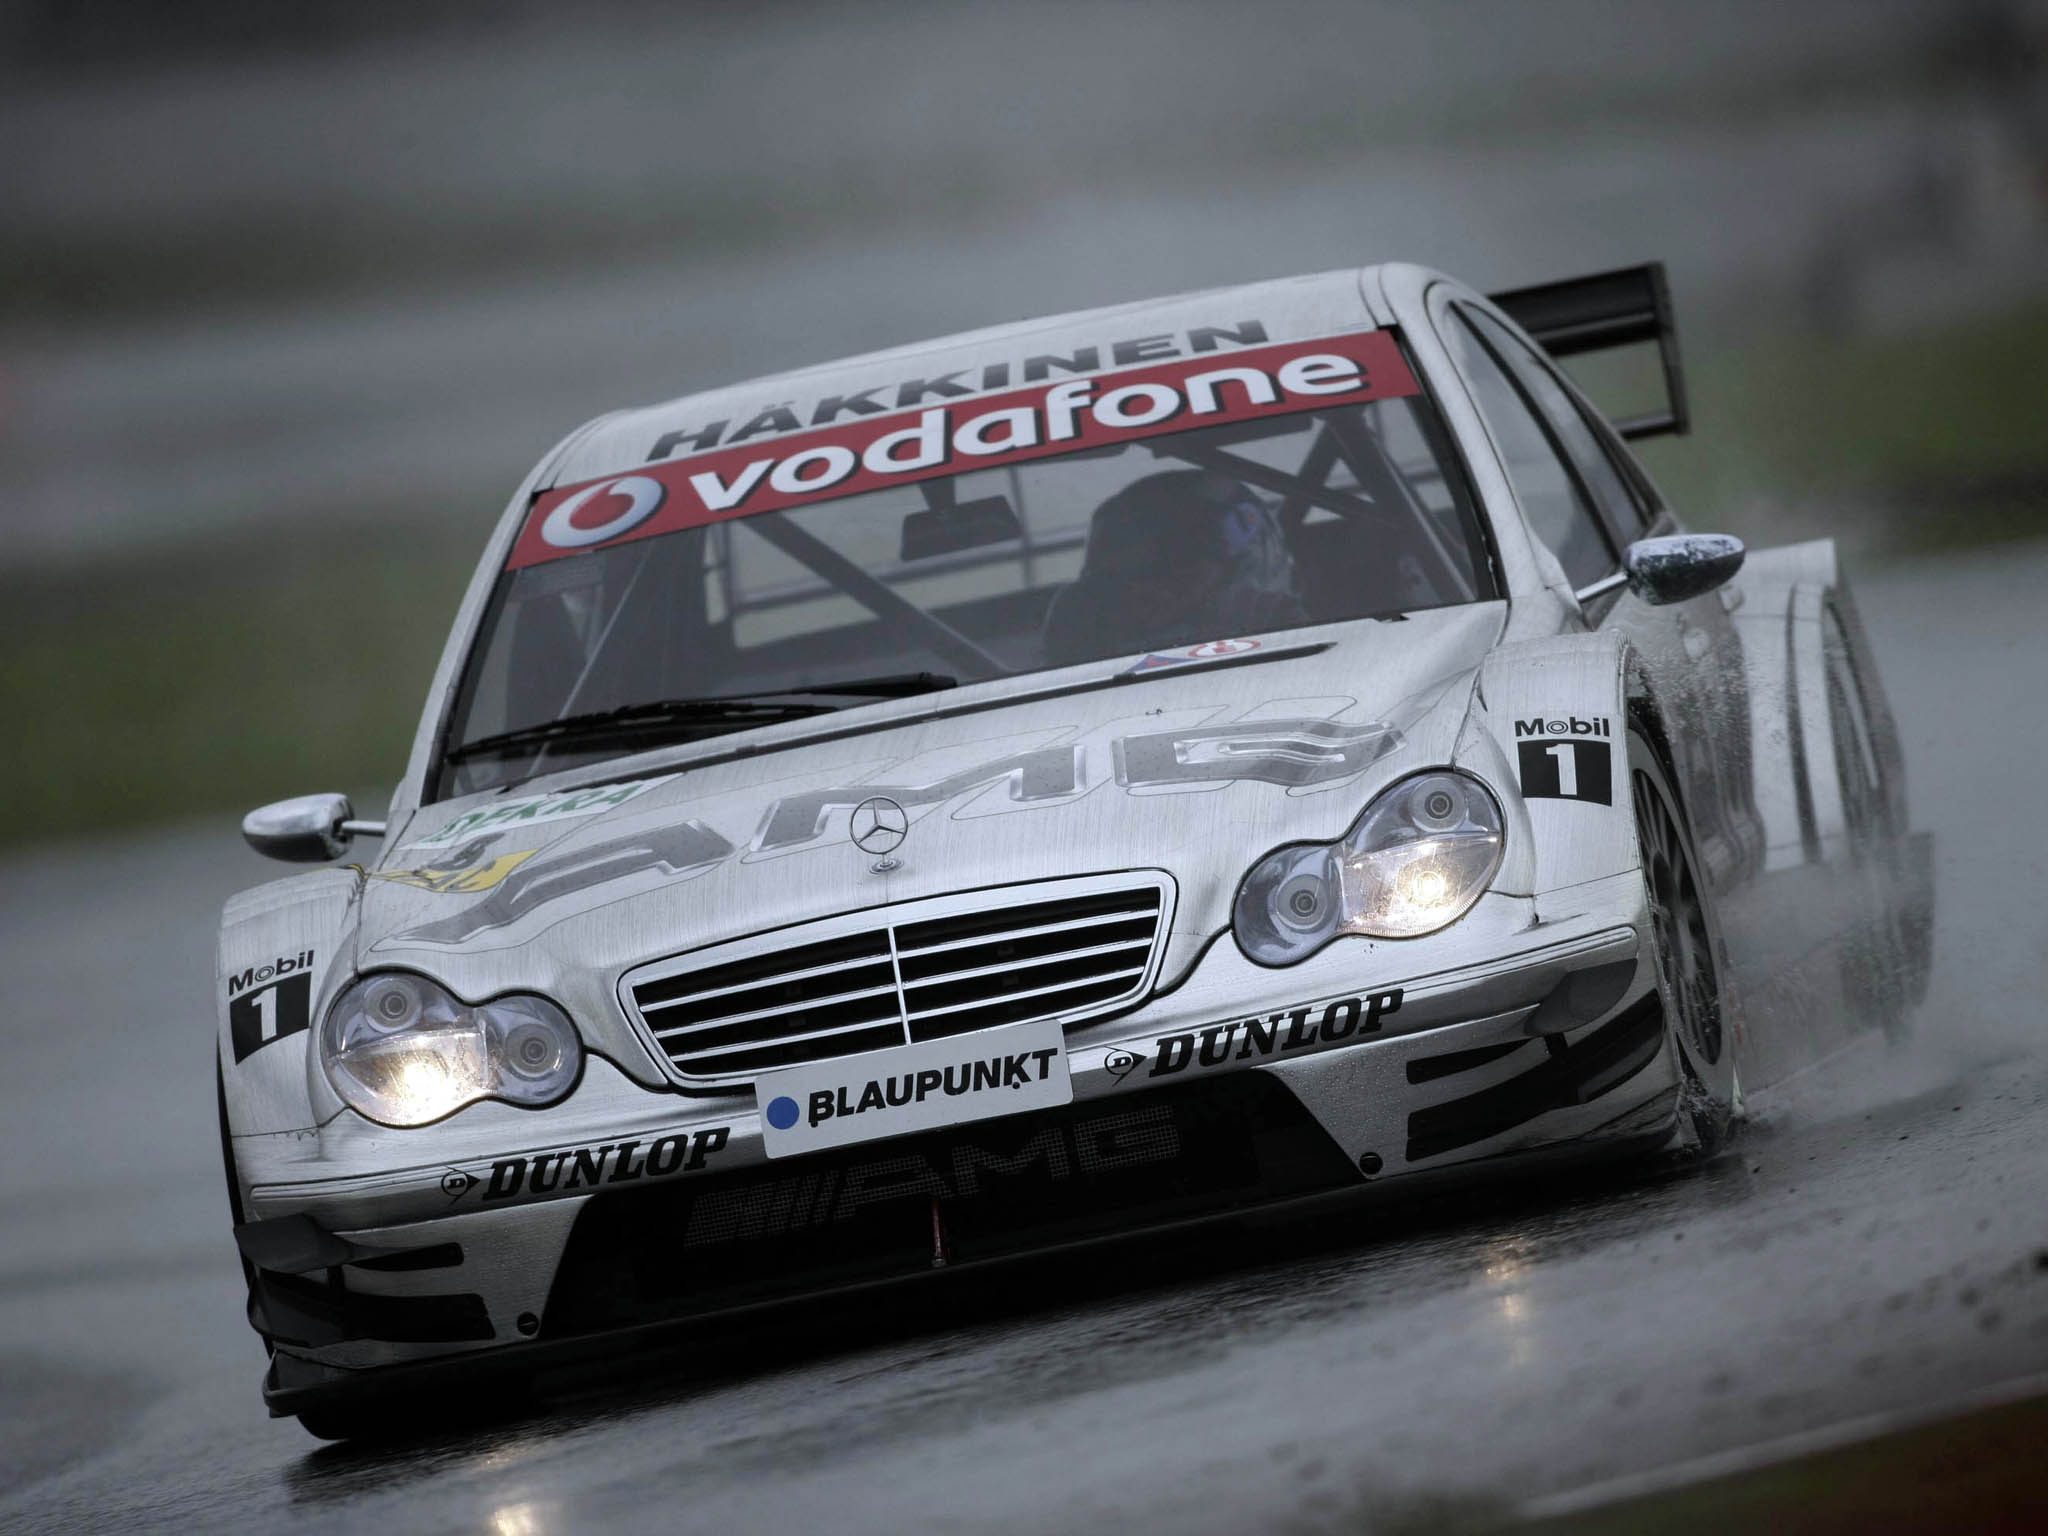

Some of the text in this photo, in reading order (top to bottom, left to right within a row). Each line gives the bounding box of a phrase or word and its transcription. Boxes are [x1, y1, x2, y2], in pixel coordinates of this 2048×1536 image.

[646, 320, 1269, 462] HÄKKINEN
[689, 354, 1368, 511] vodafone
[1514, 717, 1610, 737] Mobil
[1546, 744, 1577, 796] 1
[229, 950, 314, 996] Mobil
[252, 985, 277, 1041] 1
[1149, 988, 1404, 1078] DUNLOP
[808, 1048, 1058, 1124] BLAUPUNKT
[483, 1126, 730, 1201] DUNLOP
